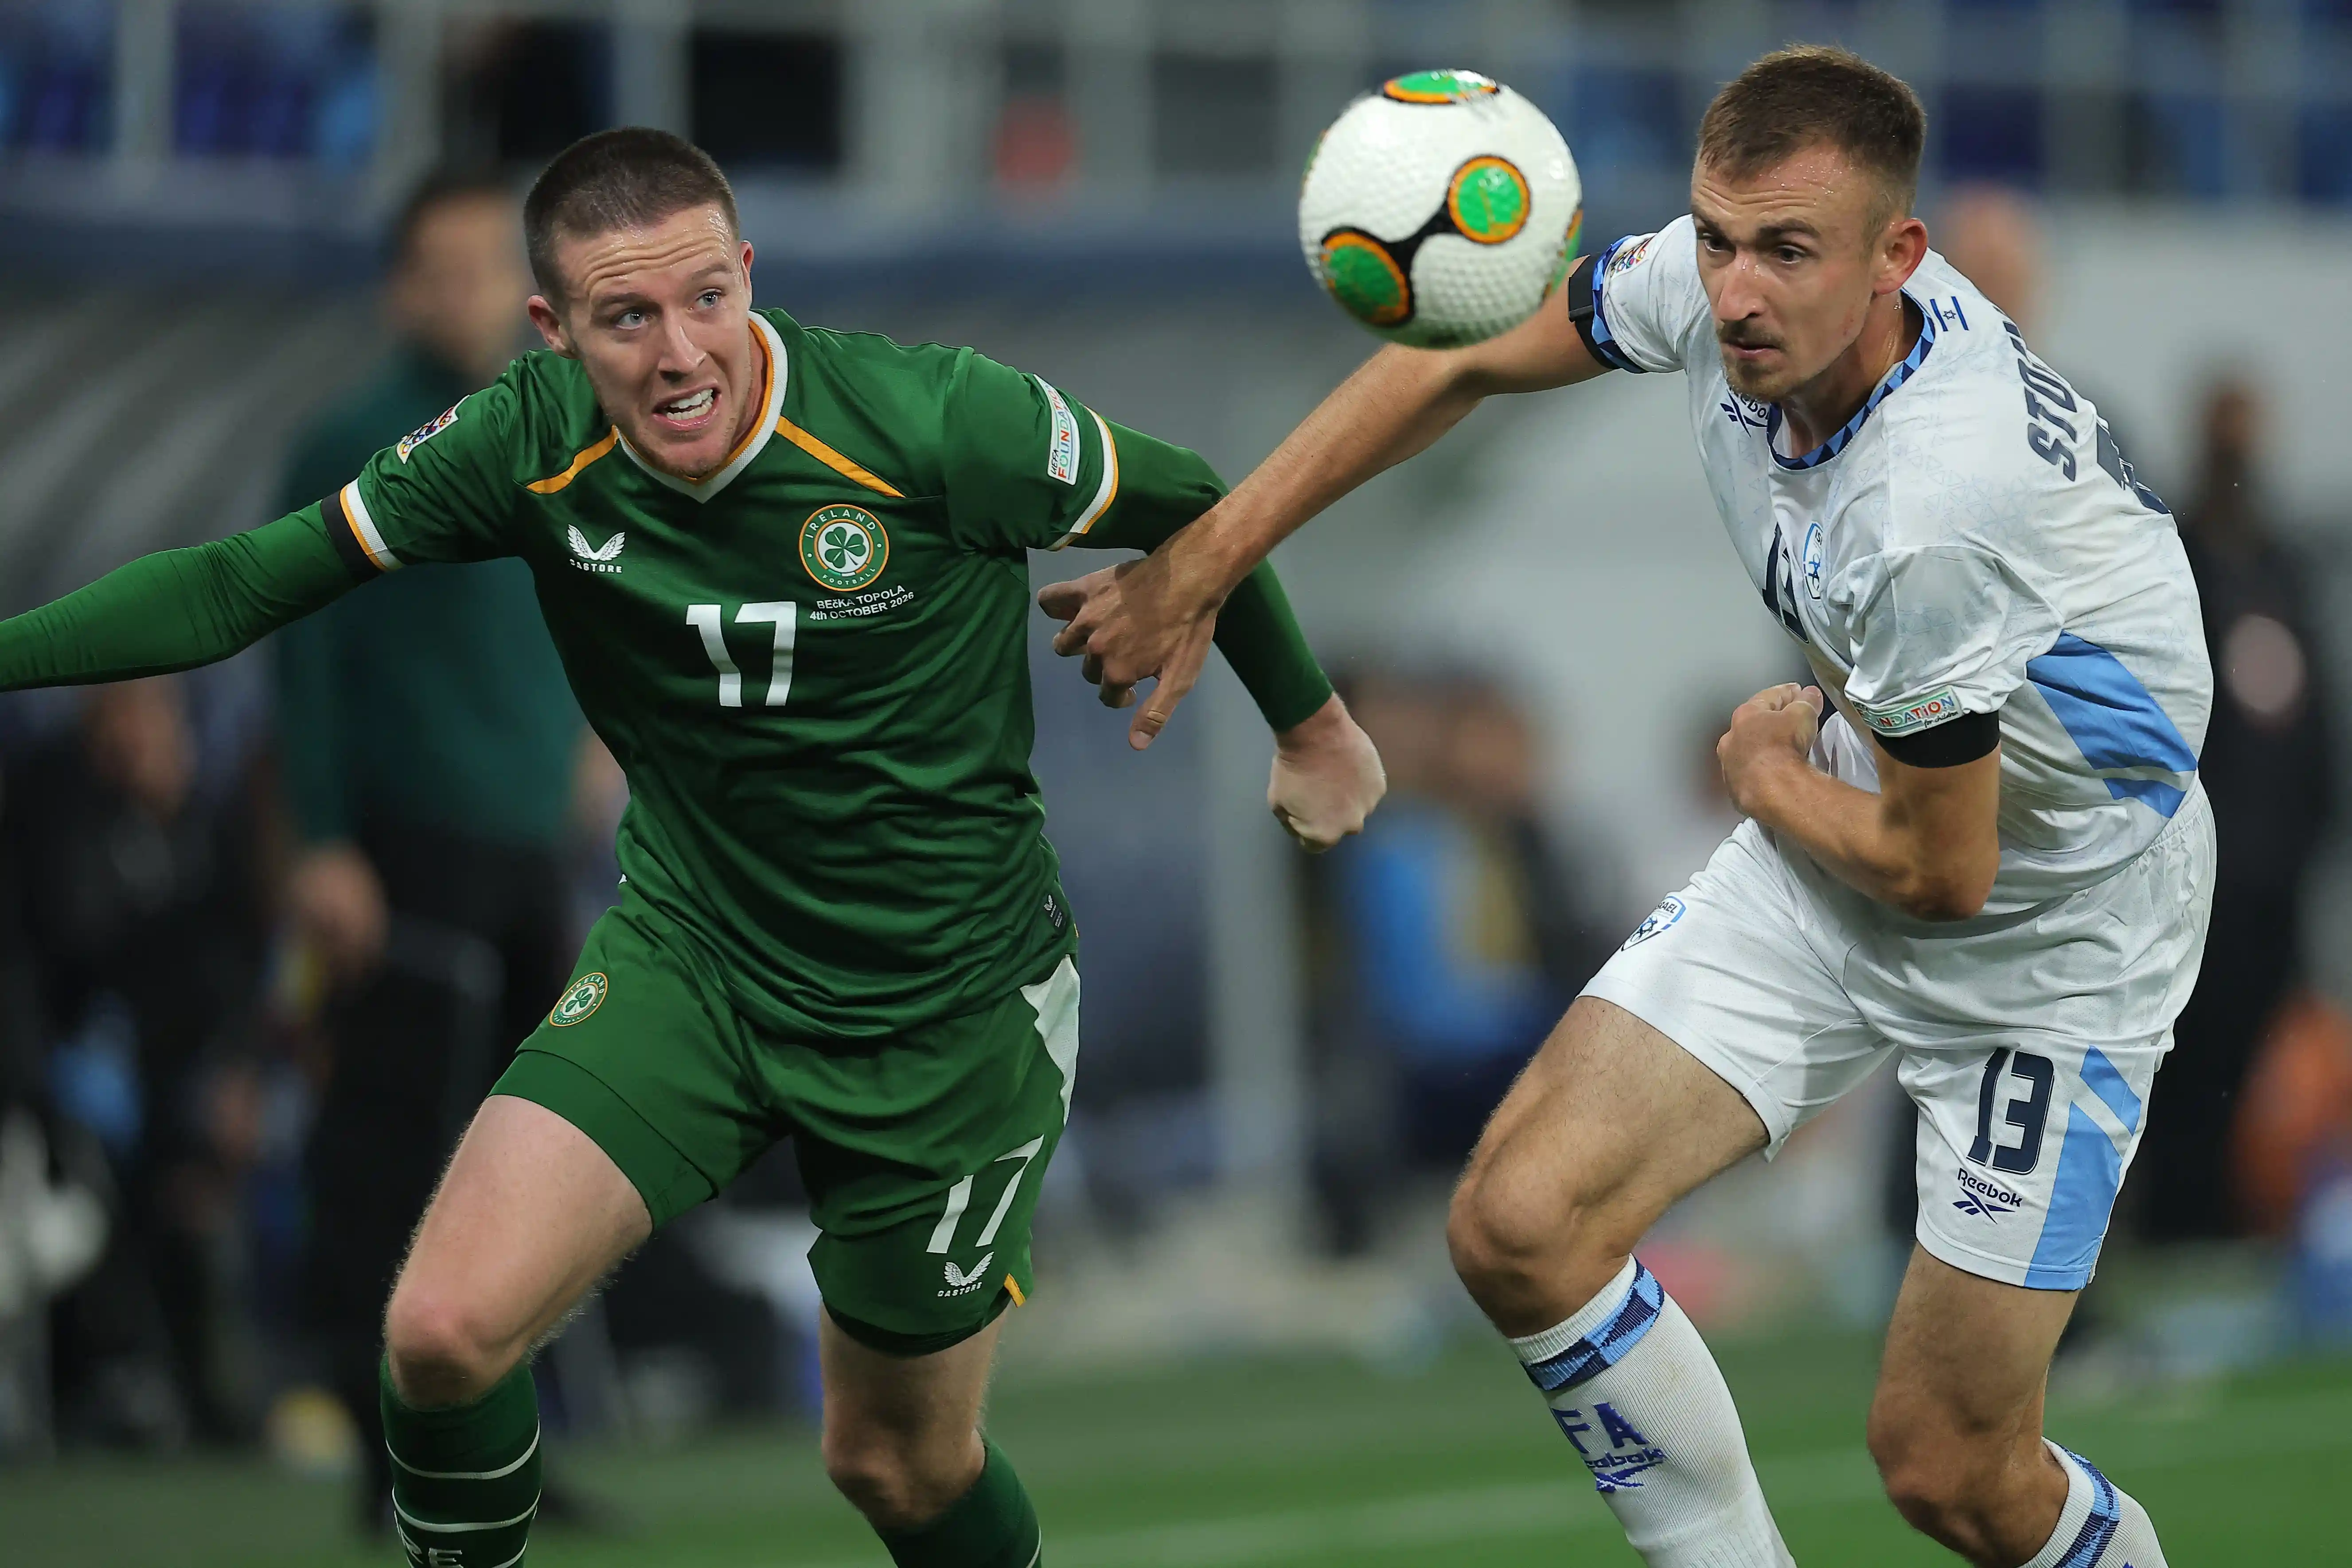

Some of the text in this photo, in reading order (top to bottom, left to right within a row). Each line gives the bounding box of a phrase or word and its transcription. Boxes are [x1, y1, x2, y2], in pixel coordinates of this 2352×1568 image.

[2003, 320, 2077, 482] STO
[805, 509, 876, 539] IRELAND
[569, 558, 622, 573] CASTORE
[822, 567, 876, 585] FOOTBALL
[809, 592, 914, 620] 4th OCTOBER 2026
[856, 585, 905, 605] TOPOLA
[686, 601, 797, 707] 17
[1966, 1047, 2055, 1176] 13
[926, 1134, 1044, 1254] 17
[1957, 1167, 2023, 1208] Reebok
